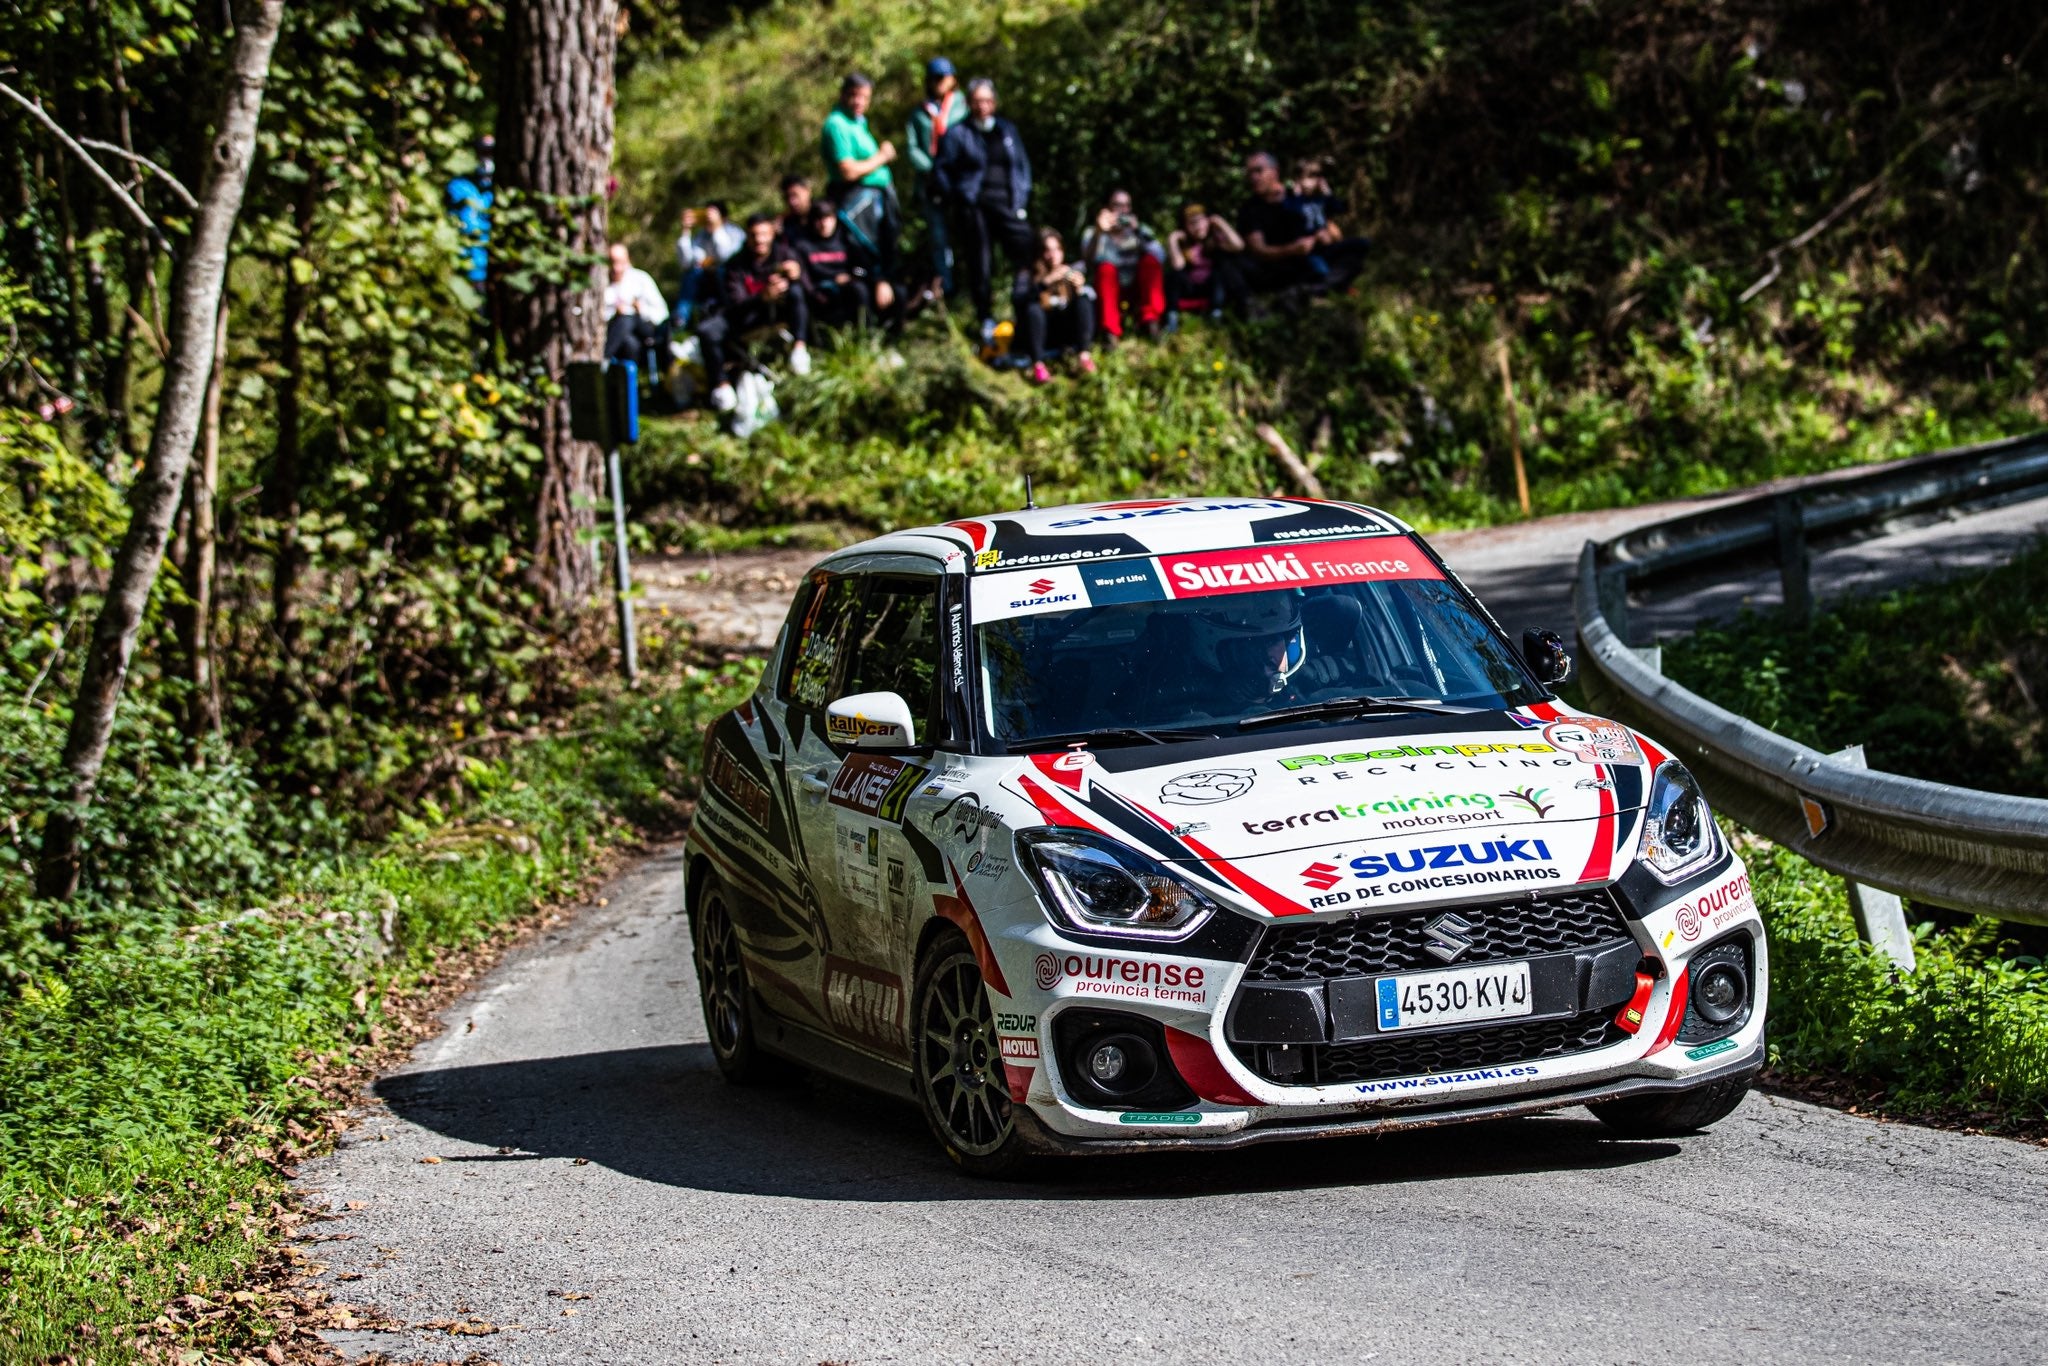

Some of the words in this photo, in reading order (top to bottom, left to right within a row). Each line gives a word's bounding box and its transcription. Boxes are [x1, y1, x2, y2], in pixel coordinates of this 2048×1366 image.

[1048, 502, 1287, 529] SUZUKI
[1273, 524, 1382, 540] ruedausada.es
[1095, 578, 1114, 587] Way
[1116, 576, 1126, 584] of
[1172, 552, 1310, 590] Suzuki
[1311, 558, 1411, 578] Finance
[1009, 594, 1077, 609] SUZUKI
[830, 715, 899, 736] Rallycar
[1298, 758, 1572, 785] RECYCLING
[831, 765, 892, 808] LLANES
[879, 766, 924, 821] 21
[1242, 791, 1496, 836] terratraining
[1382, 809, 1504, 830] motorsport
[1349, 839, 1553, 879] SUZUKI
[1310, 892, 1351, 908] RED
[1357, 885, 1384, 900] DE
[1388, 868, 1561, 895] CONCESIONARIOS
[1713, 899, 1751, 929] provincia
[1064, 954, 1205, 988] ourense
[1075, 979, 1149, 998] provincia
[1154, 985, 1206, 1004] termal
[1384, 1008, 1393, 1020] E
[1402, 980, 1468, 1015] 4530
[1476, 973, 1526, 1008] KVJ
[997, 1013, 1037, 1032] REDUR
[1002, 1040, 1038, 1056] MOTUL
[1355, 1064, 1540, 1094] www.suzuki.es
[1127, 1114, 1195, 1122] TRADISA
